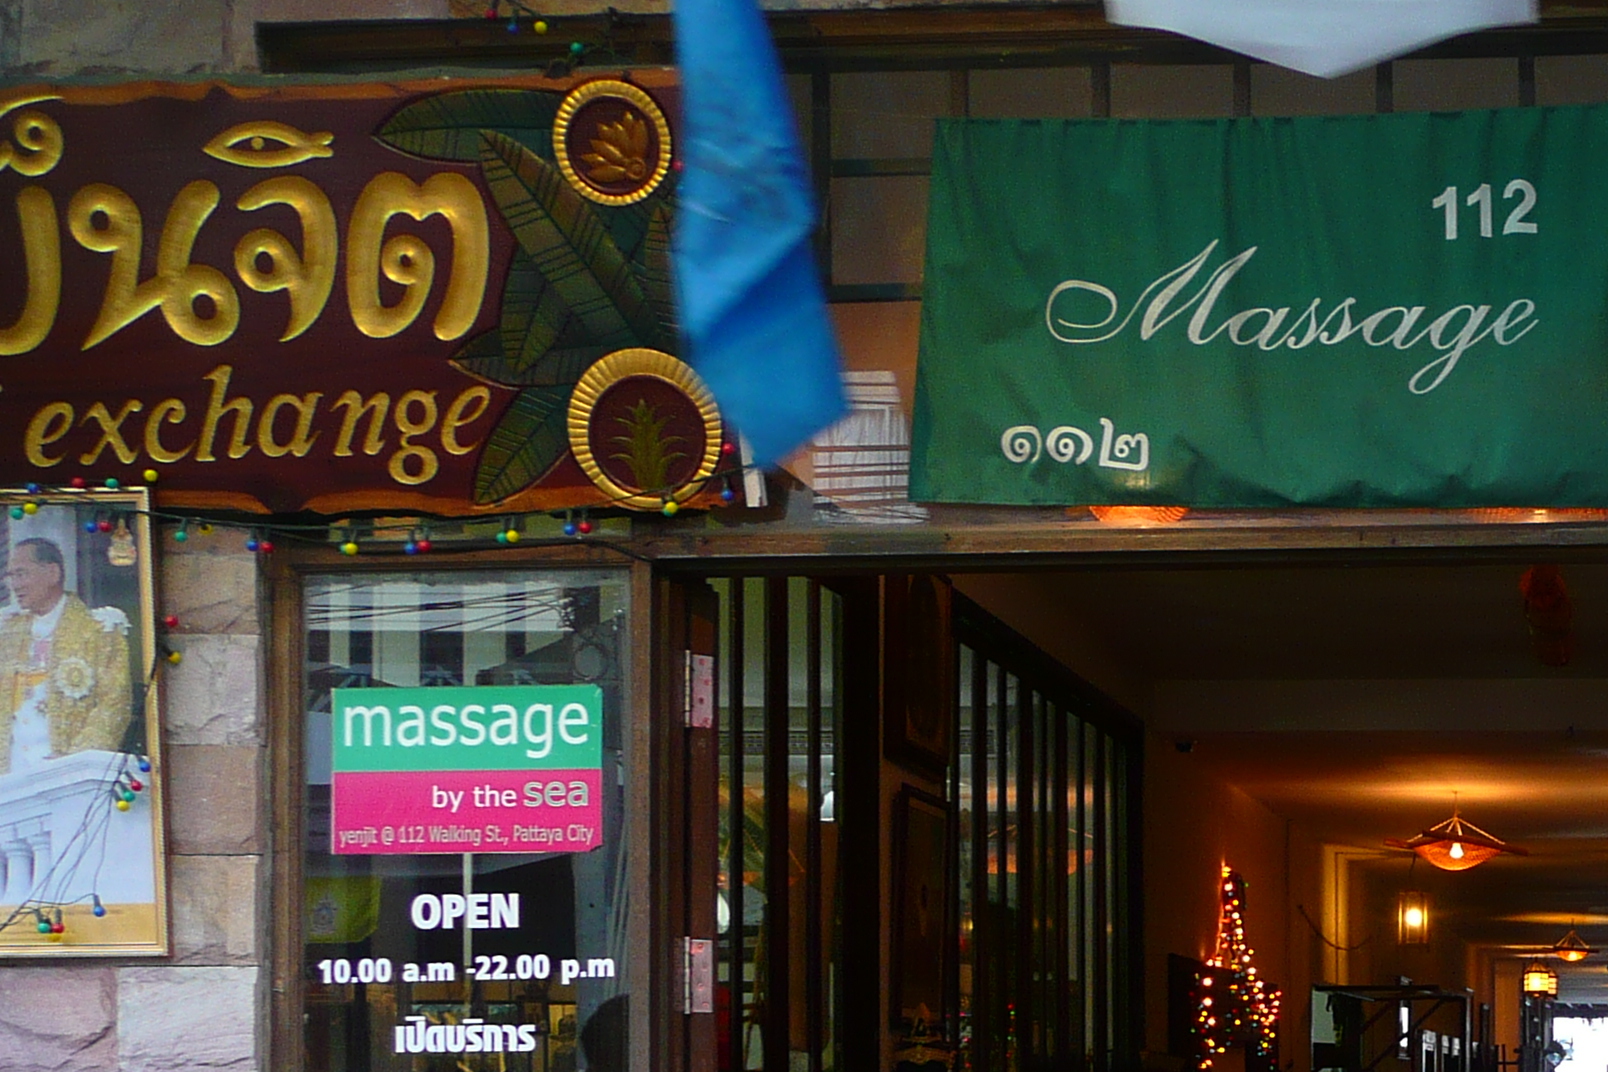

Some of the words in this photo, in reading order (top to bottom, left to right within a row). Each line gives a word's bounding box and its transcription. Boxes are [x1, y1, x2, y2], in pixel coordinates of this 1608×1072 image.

[1432, 178, 1538, 241] 112
[1045, 238, 1539, 395] Massage
[24, 365, 491, 486] exchange
[1001, 417, 1150, 472] ๑๑๒
[342, 701, 589, 758] massage
[431, 784, 464, 813] by
[473, 784, 518, 808] the
[522, 779, 589, 808] sea
[339, 826, 378, 847] yenjit
[381, 826, 395, 845] @
[398, 826, 425, 843] 112
[428, 824, 482, 846] Walking
[513, 824, 563, 846] Pattaya
[566, 824, 594, 845] City
[411, 893, 520, 930] OPEN
[317, 957, 392, 984] 10.00
[402, 959, 455, 982] a.m
[561, 956, 615, 985] p.m
[394, 1015, 537, 1054] เปิดบริการ
